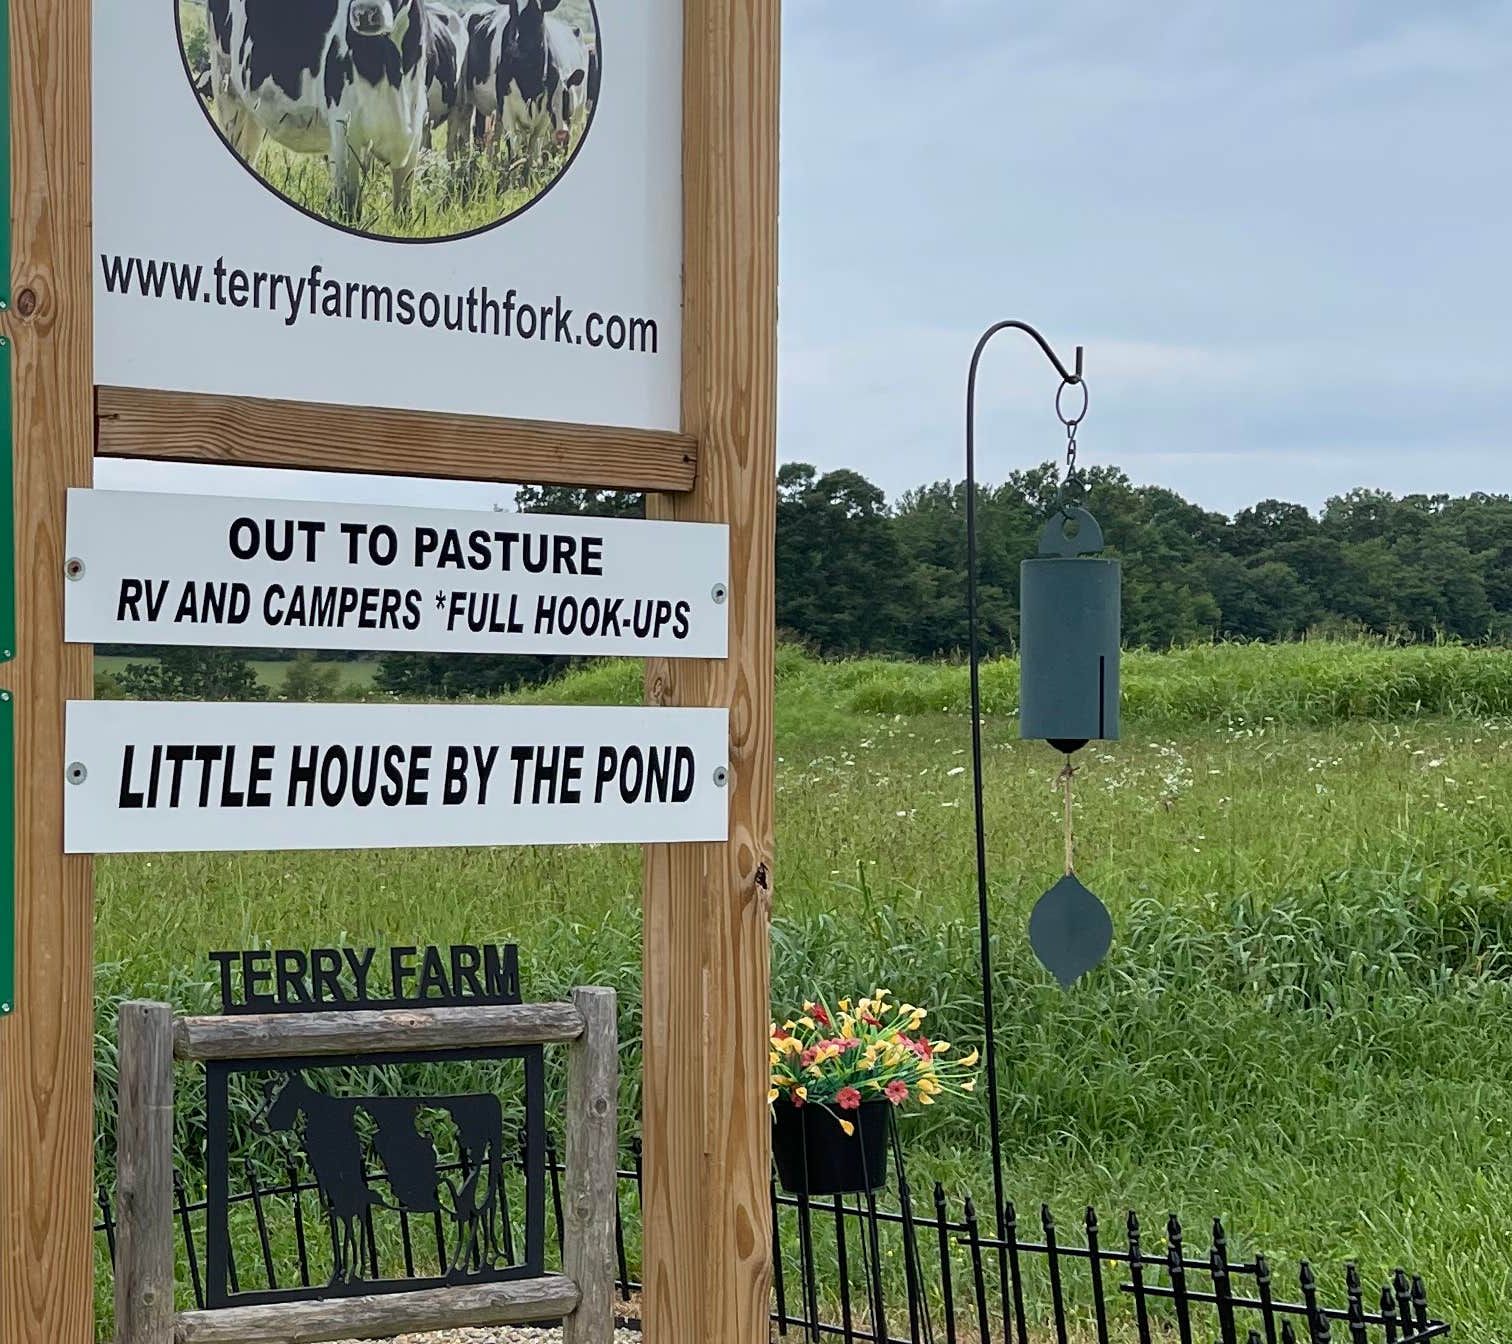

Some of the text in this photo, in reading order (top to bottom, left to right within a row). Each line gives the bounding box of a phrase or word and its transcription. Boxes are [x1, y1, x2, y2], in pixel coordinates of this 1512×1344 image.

[101, 254, 658, 354] www.terryfarmsouthfork.com
[229, 517, 603, 577] OUT TO PASTURE
[117, 579, 170, 622] RV
[174, 581, 251, 625] AND
[263, 584, 423, 631] CAMPERS
[534, 595, 691, 640] HOOK-UPS
[118, 744, 695, 809] LITTLE HOUSE BY THE POND
[209, 943, 520, 1009] TERRY FARM
